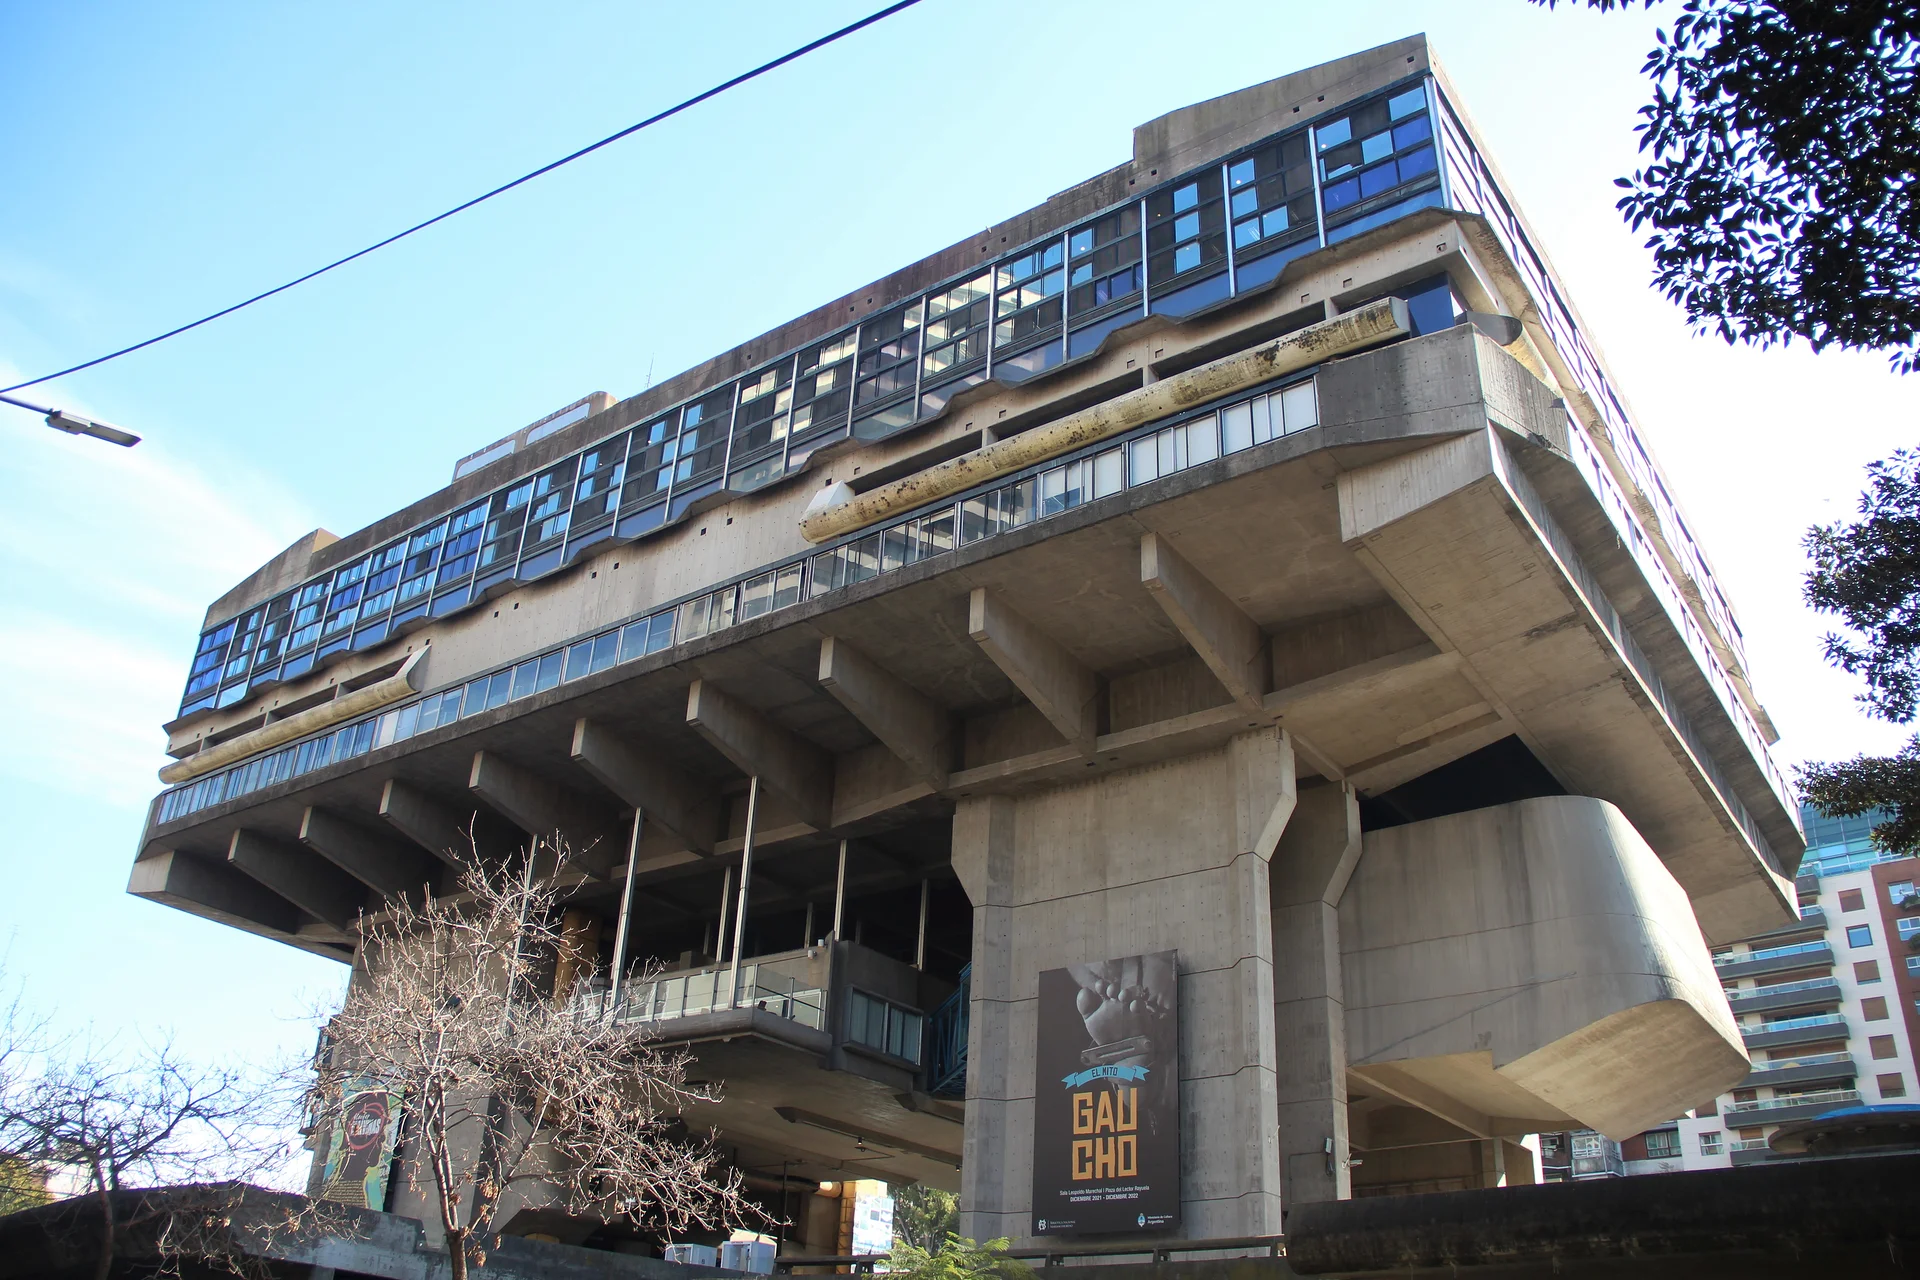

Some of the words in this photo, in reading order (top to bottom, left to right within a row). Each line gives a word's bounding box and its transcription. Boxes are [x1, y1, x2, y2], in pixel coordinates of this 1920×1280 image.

[1091, 1068, 1100, 1078] EL
[1102, 1066, 1118, 1076] MITO
[1072, 1087, 1138, 1135] GAU
[1072, 1134, 1138, 1181] CHO
